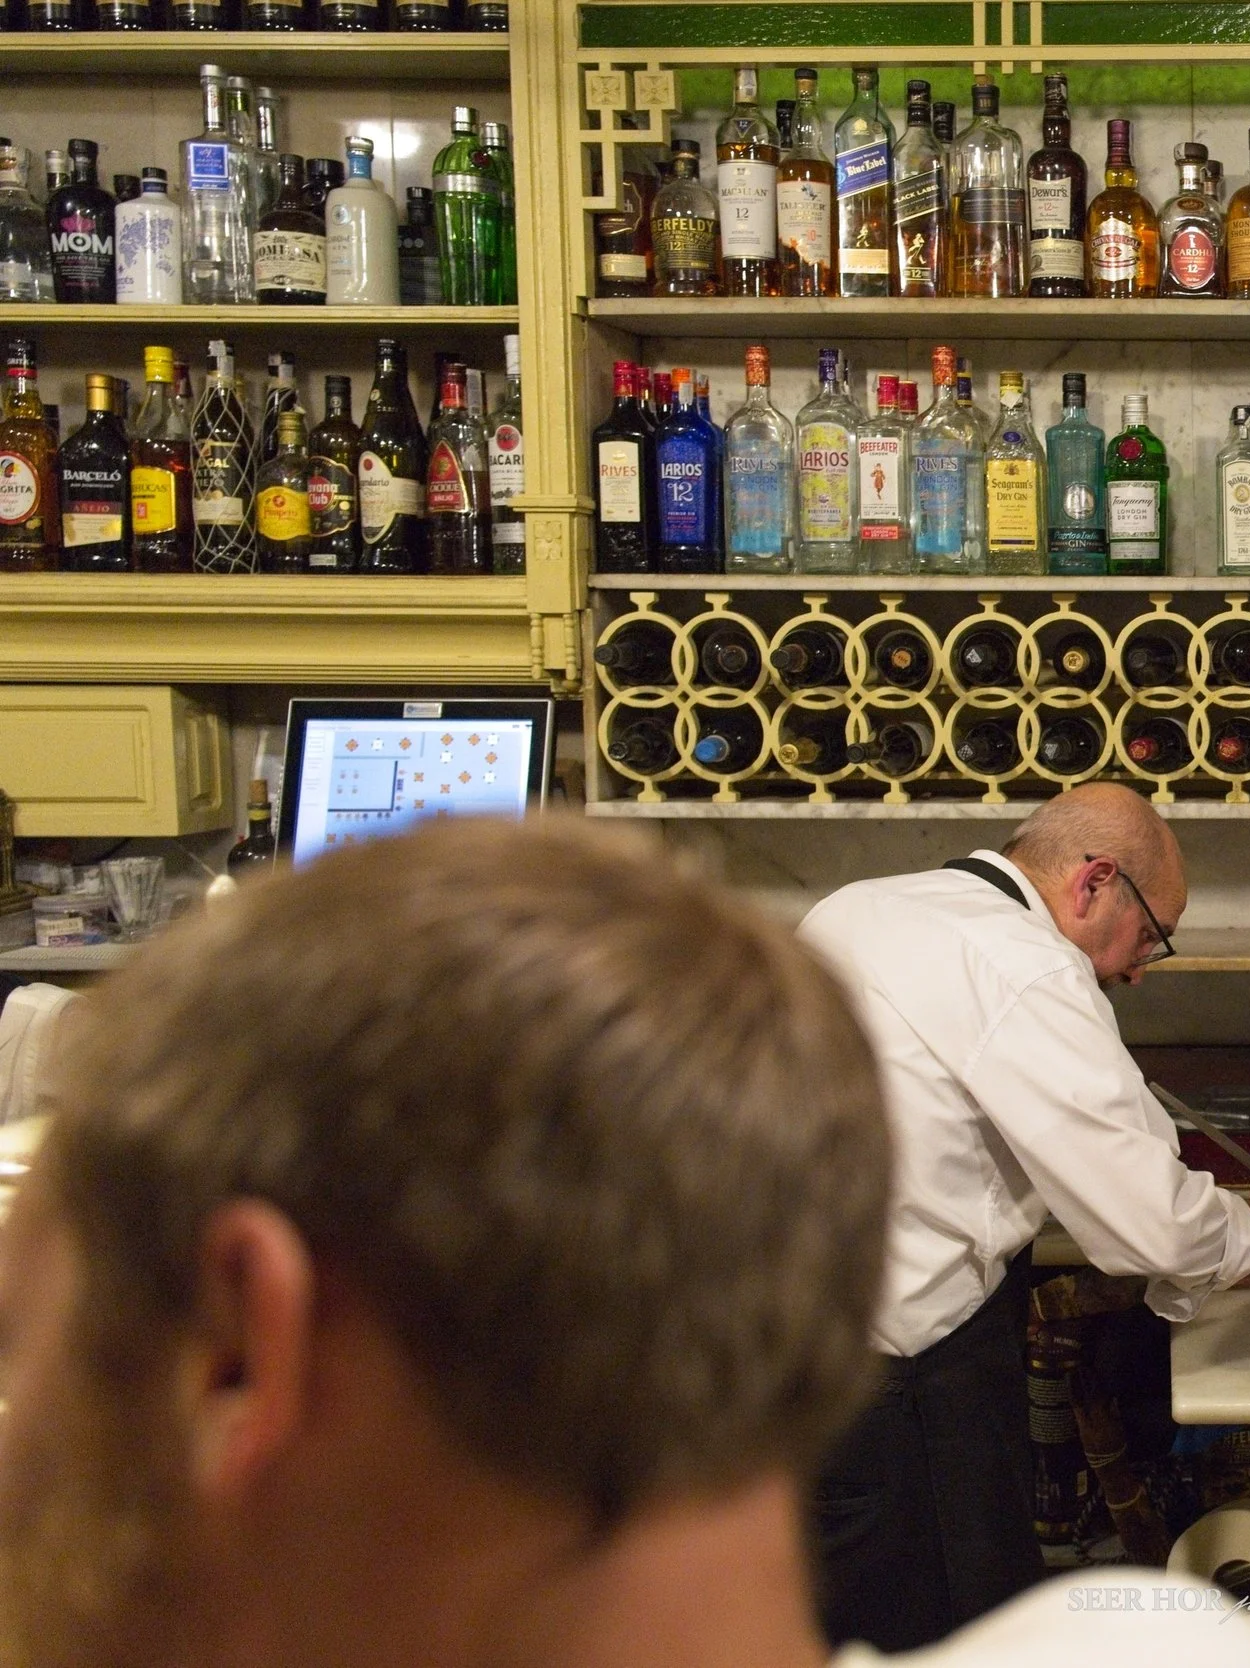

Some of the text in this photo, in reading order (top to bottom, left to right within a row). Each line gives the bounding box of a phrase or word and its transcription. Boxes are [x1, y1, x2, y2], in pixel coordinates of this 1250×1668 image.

[845, 156, 887, 178] Blue Label
[735, 208, 749, 219] 12
[653, 218, 715, 232] BERFELDY
[51, 232, 113, 255] MOM
[668, 240, 683, 251] 12
[1172, 248, 1214, 257] CARDHU
[911, 270, 922, 278] 12
[1187, 264, 1199, 273] 12
[860, 442, 898, 455] BEEFEATER
[731, 456, 779, 474] RIVES
[800, 451, 849, 472] LARIOS
[917, 456, 958, 474] RIVES
[63, 469, 122, 483] BARCELÓ
[601, 465, 638, 477] RIVES
[661, 462, 703, 480] LARIOS
[992, 478, 1034, 491] Seagram's
[667, 481, 694, 502] 12
[997, 492, 1028, 501] DRY GIN
[309, 493, 329, 506] Club
[1112, 495, 1154, 507] Tanqueray
[1229, 501, 1243, 510] DRY
[1068, 540, 1087, 548] GIN
